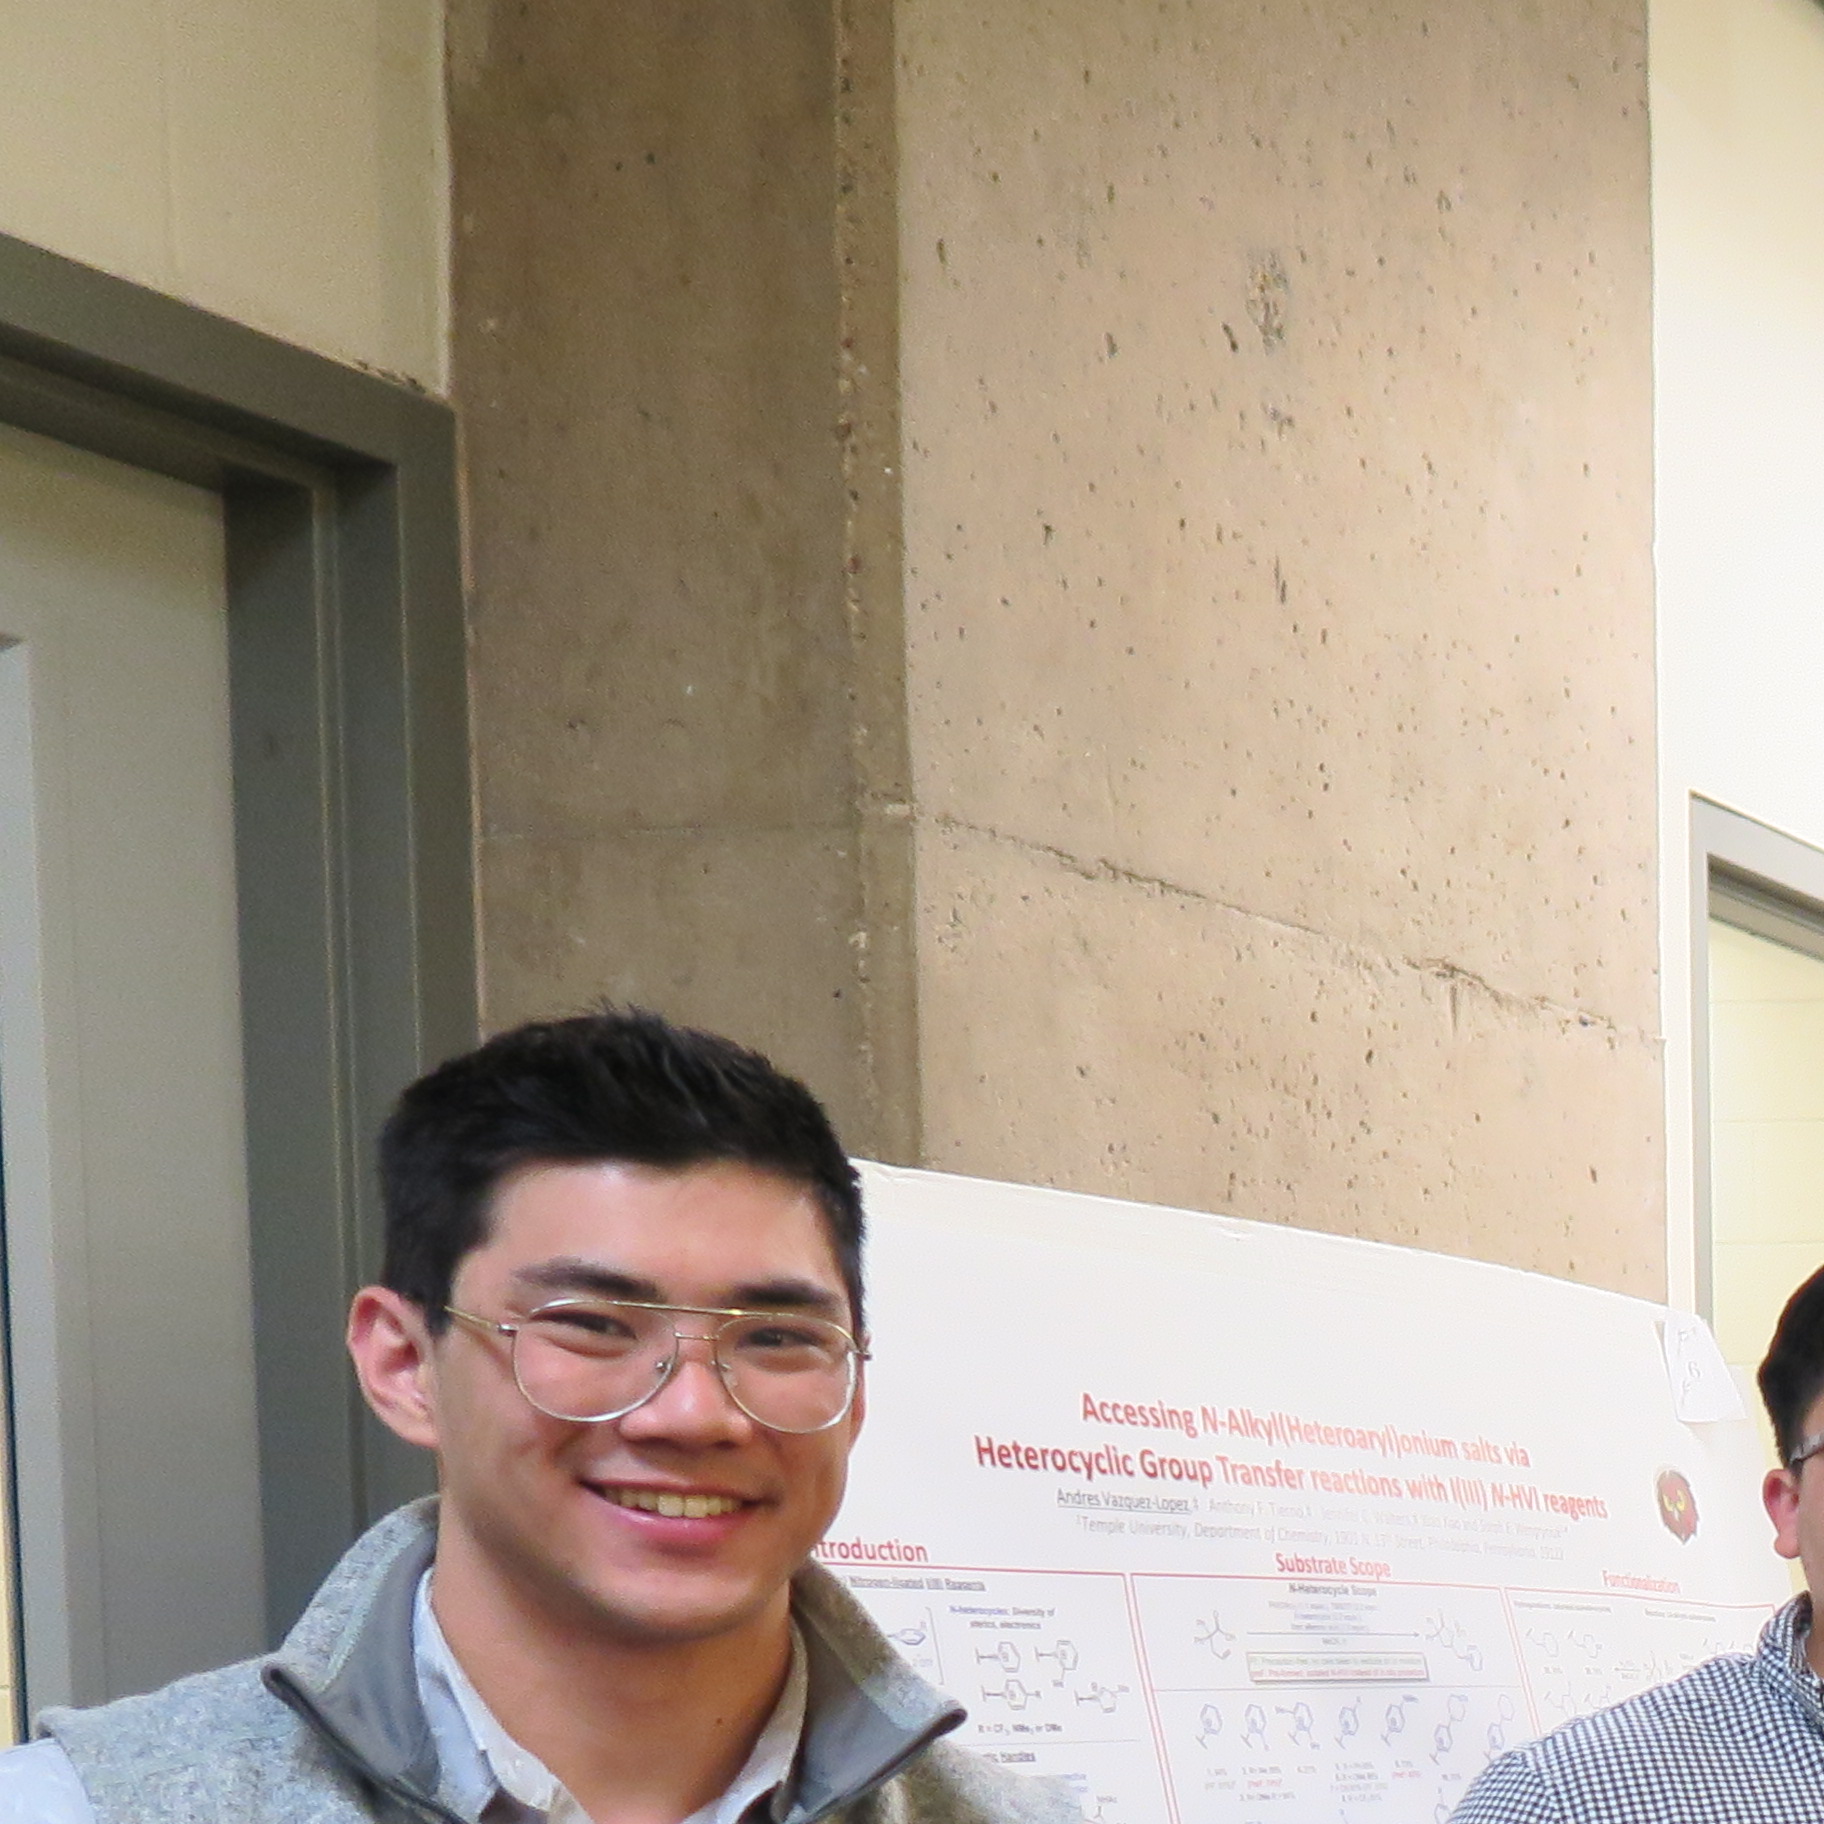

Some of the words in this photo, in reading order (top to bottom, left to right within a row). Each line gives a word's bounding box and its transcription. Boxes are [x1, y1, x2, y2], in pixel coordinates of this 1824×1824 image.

[1082, 1393, 1196, 1438] Accessing
[1200, 1406, 1457, 1459] N-Alkyl(Heteroaryl)onium
[1462, 1435, 1501, 1464] salts
[1505, 1442, 1531, 1467] via
[975, 1435, 1134, 1482] Heterocyclic
[1140, 1449, 1212, 1488] Group
[1215, 1454, 1304, 1490] Transfer
[1312, 1469, 1403, 1498] reactions
[1406, 1474, 1446, 1502] with
[1451, 1477, 1488, 1512] I(III)
[1492, 1482, 1539, 1510] N-HVI
[1544, 1492, 1608, 1520] reagents
[1057, 1488, 1100, 1506] Andres
[1276, 1552, 1346, 1574] Substrate
[1350, 1557, 1391, 1579] Scope
